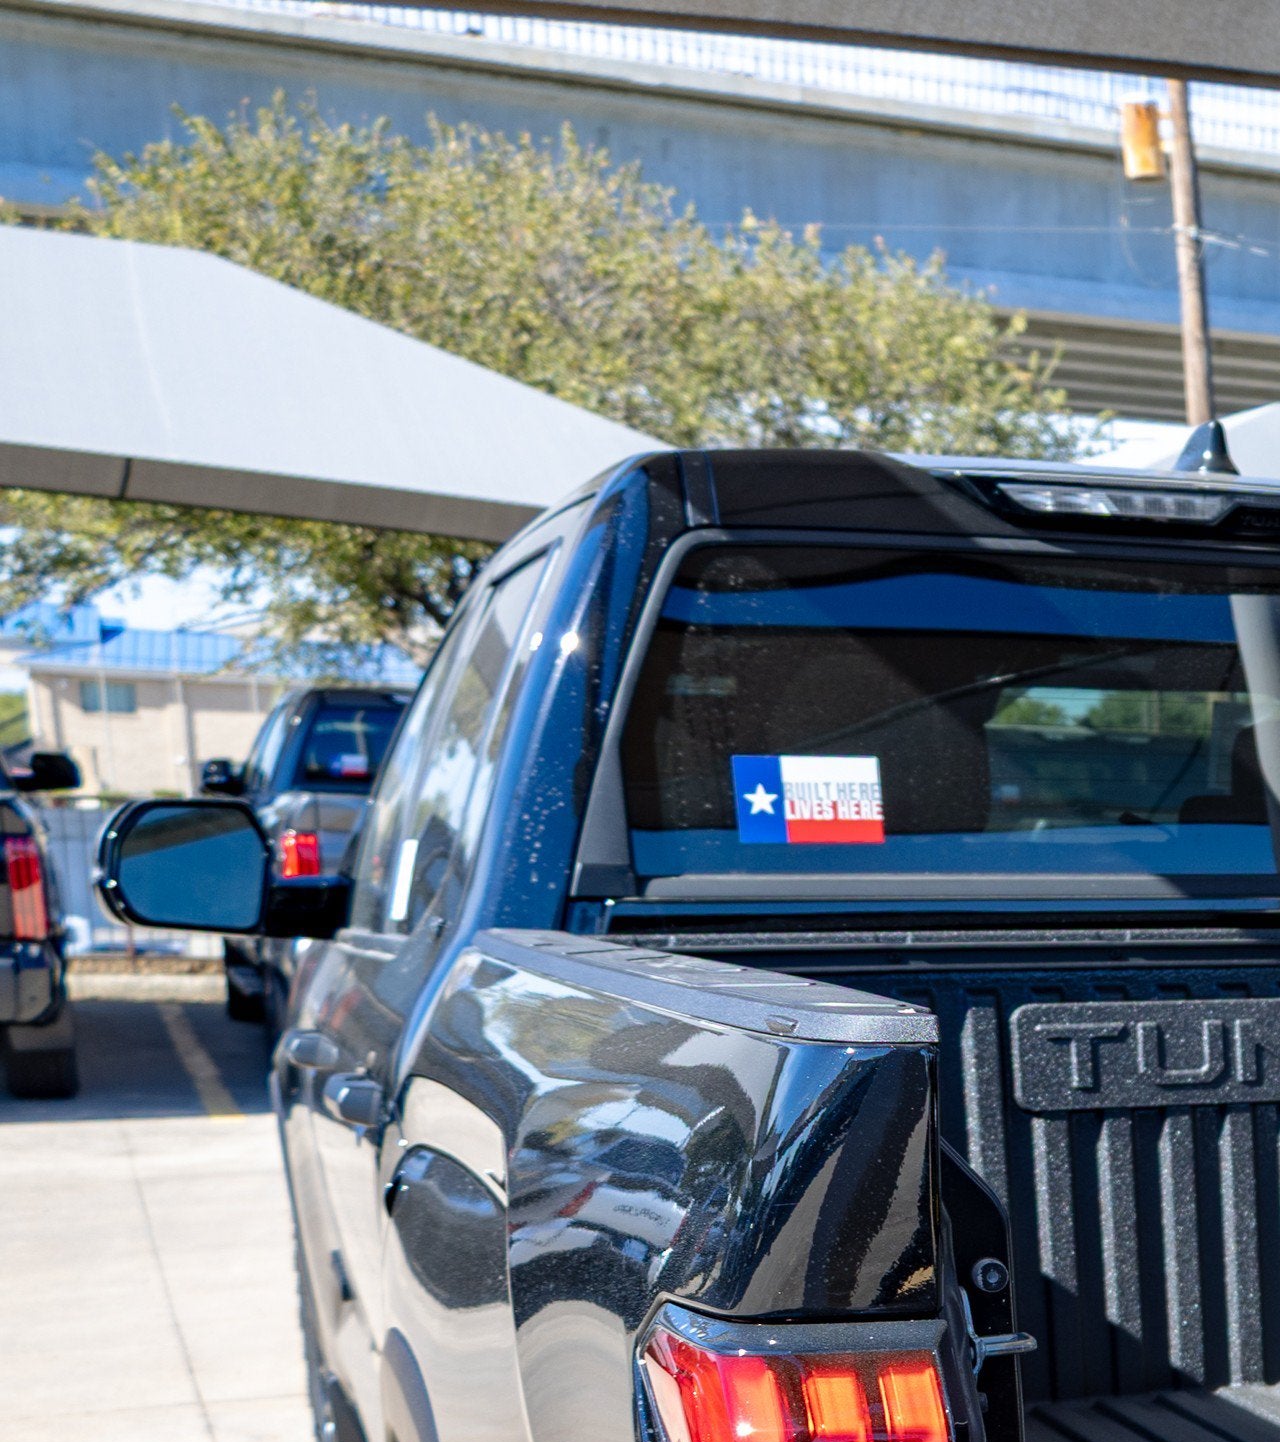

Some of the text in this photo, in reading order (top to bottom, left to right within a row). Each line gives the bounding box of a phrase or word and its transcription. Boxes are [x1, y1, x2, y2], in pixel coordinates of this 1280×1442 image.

[785, 782, 881, 801] BUILT HERE
[785, 801, 884, 820] LIVES HERE
